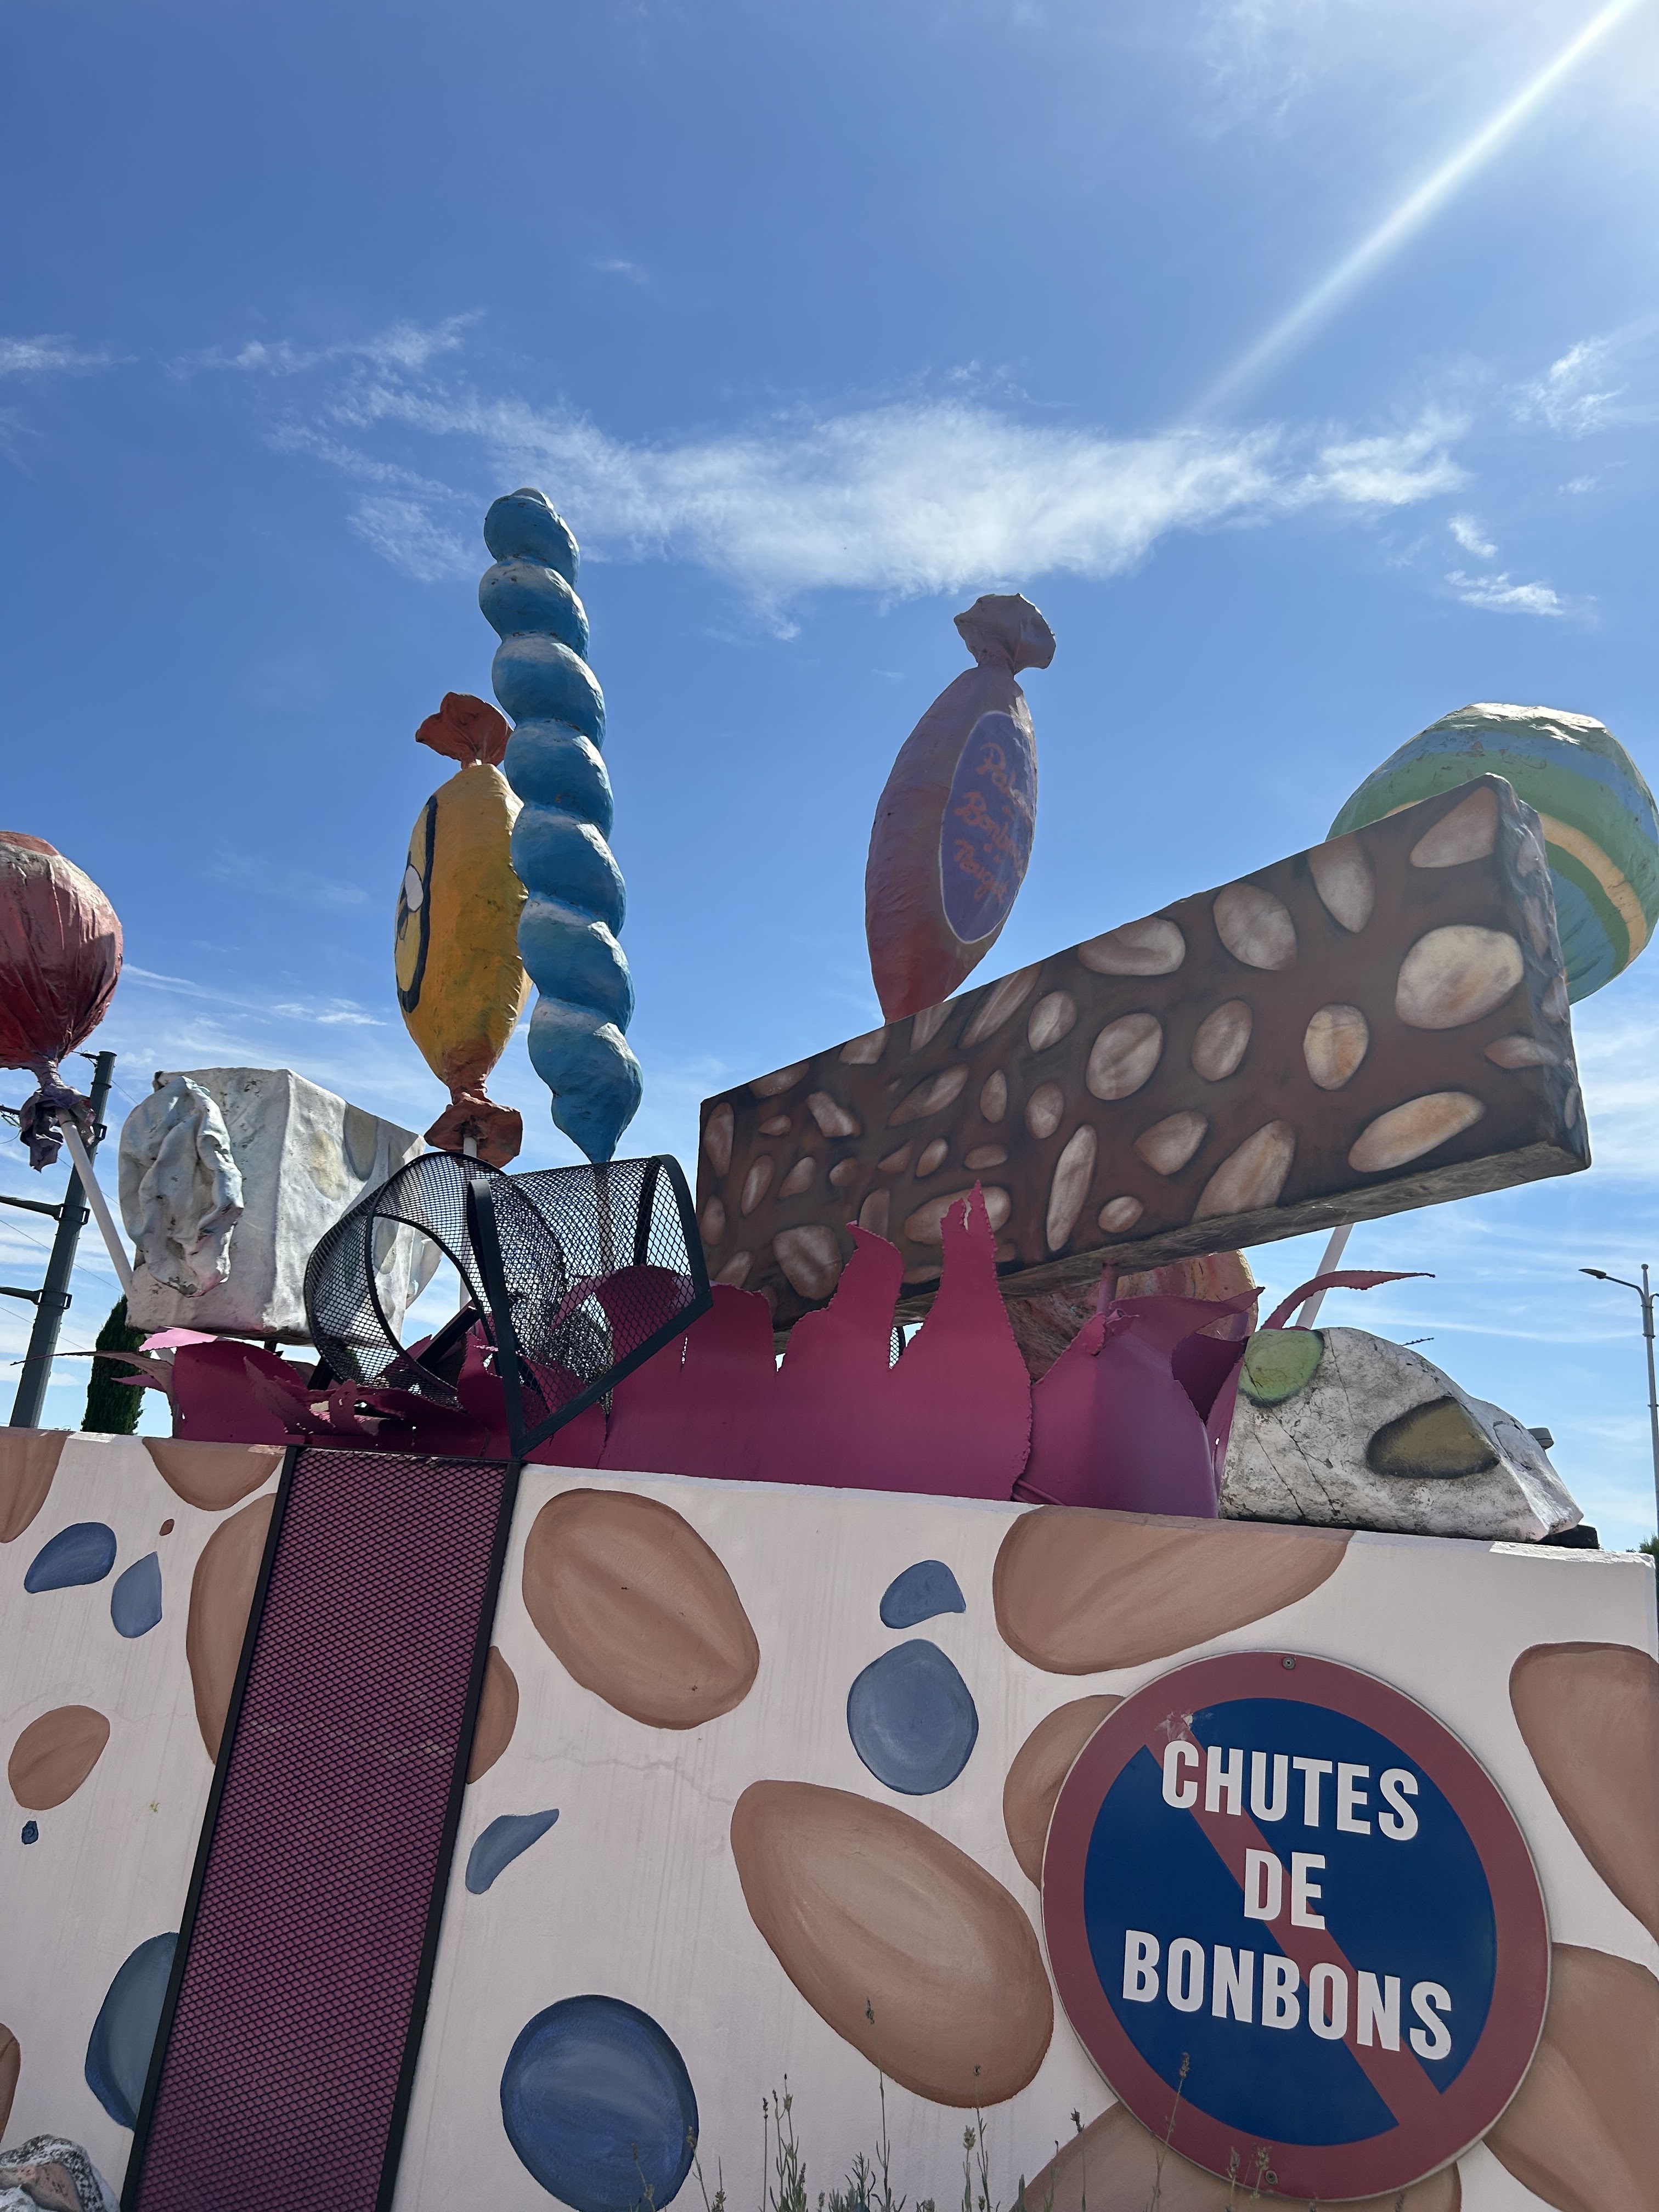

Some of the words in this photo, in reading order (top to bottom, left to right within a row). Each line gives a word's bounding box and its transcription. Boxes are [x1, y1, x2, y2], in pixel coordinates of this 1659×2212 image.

[1161, 1740, 1419, 1841] CHUTES
[1243, 1848, 1326, 1931] DE
[1122, 1929, 1452, 2061] BONBONS
